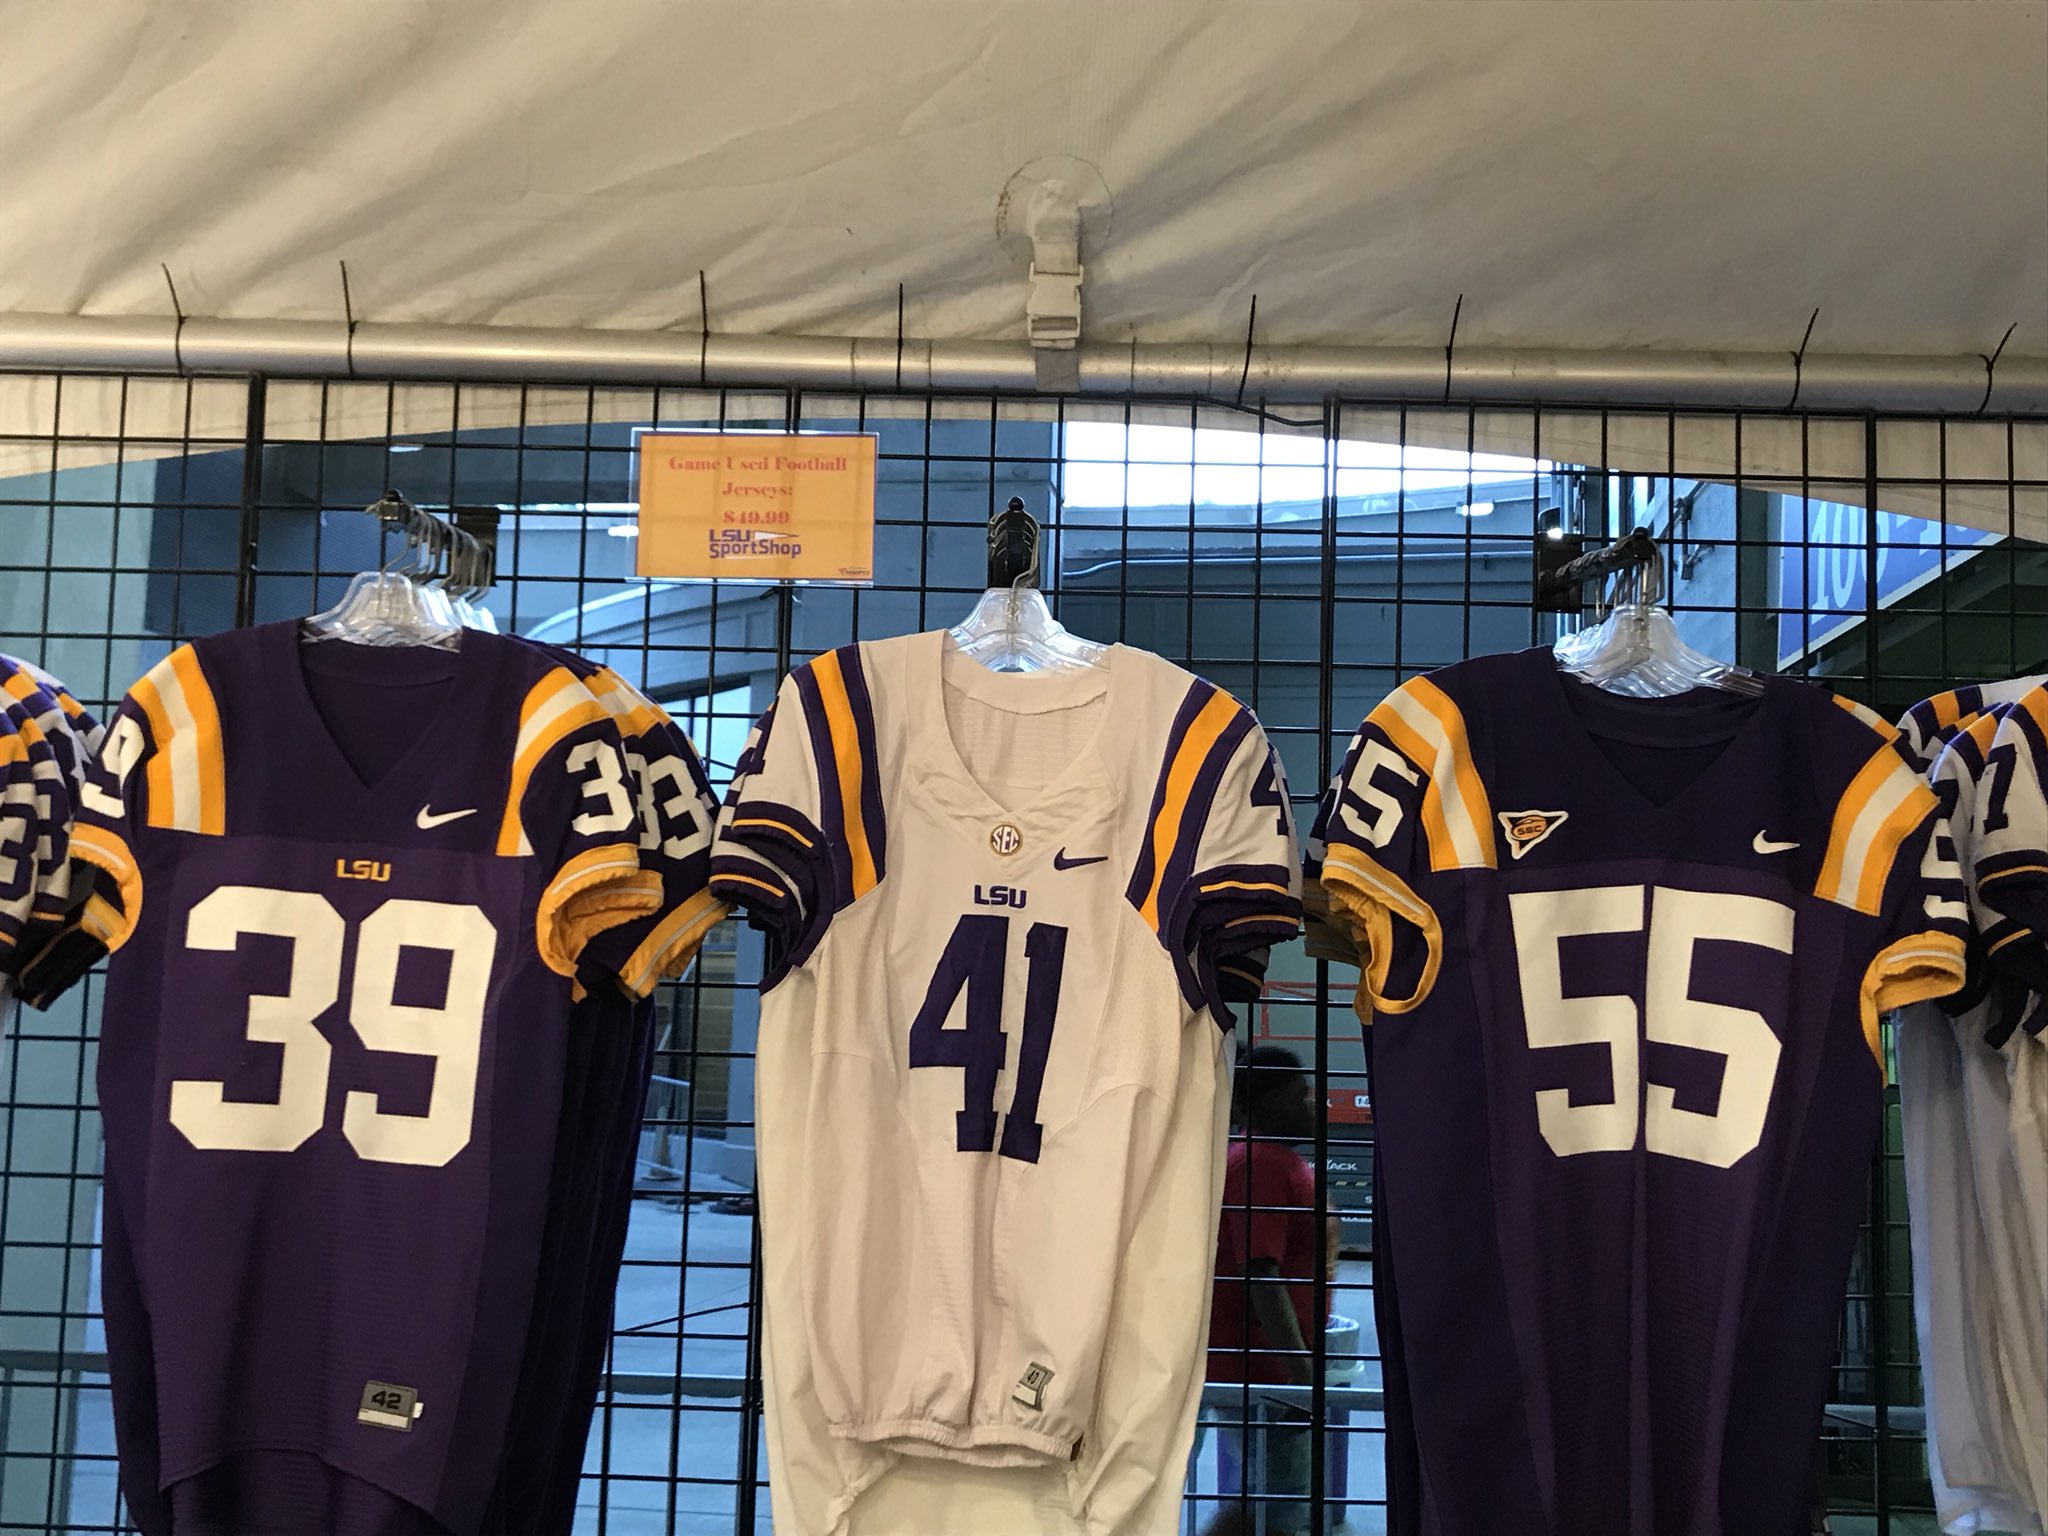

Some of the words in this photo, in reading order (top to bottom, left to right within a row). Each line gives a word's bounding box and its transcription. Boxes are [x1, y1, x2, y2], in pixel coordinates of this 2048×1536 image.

[668, 456, 721, 470] Game
[726, 456, 768, 470] Used
[775, 456, 847, 471] Football
[723, 510, 790, 525] $49.99
[709, 528, 751, 542] LSU
[709, 539, 802, 559] SportShop
[566, 739, 635, 836] 3
[1339, 738, 1420, 849] 5
[992, 825, 1020, 854] SEC
[1517, 824, 1543, 836] SEC
[336, 858, 391, 882] LSU
[974, 884, 1027, 909] LSU
[169, 885, 497, 1167] 39
[1508, 884, 1796, 1169] 55
[909, 914, 1069, 1164] 41
[371, 1390, 402, 1410] 42
